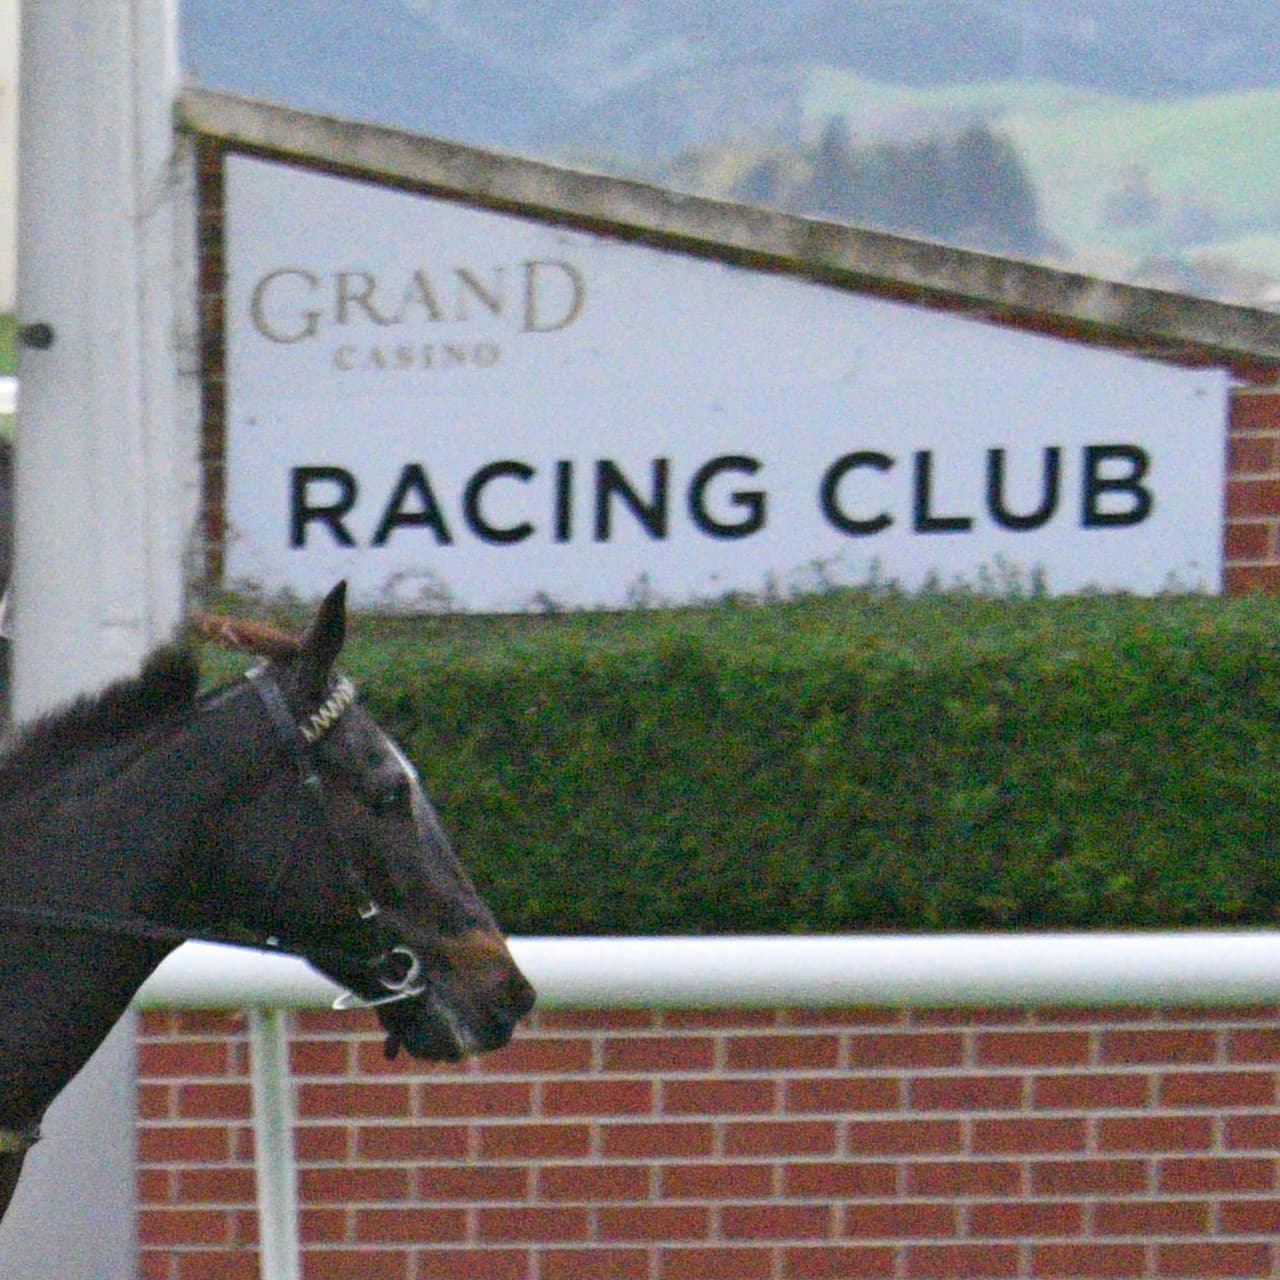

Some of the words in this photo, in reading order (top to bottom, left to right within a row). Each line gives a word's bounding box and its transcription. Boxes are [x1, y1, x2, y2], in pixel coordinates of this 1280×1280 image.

[248, 259, 585, 345] GRAND
[333, 342, 500, 371] CASINO
[288, 455, 769, 547] RACING
[818, 444, 1155, 534] CLUB
